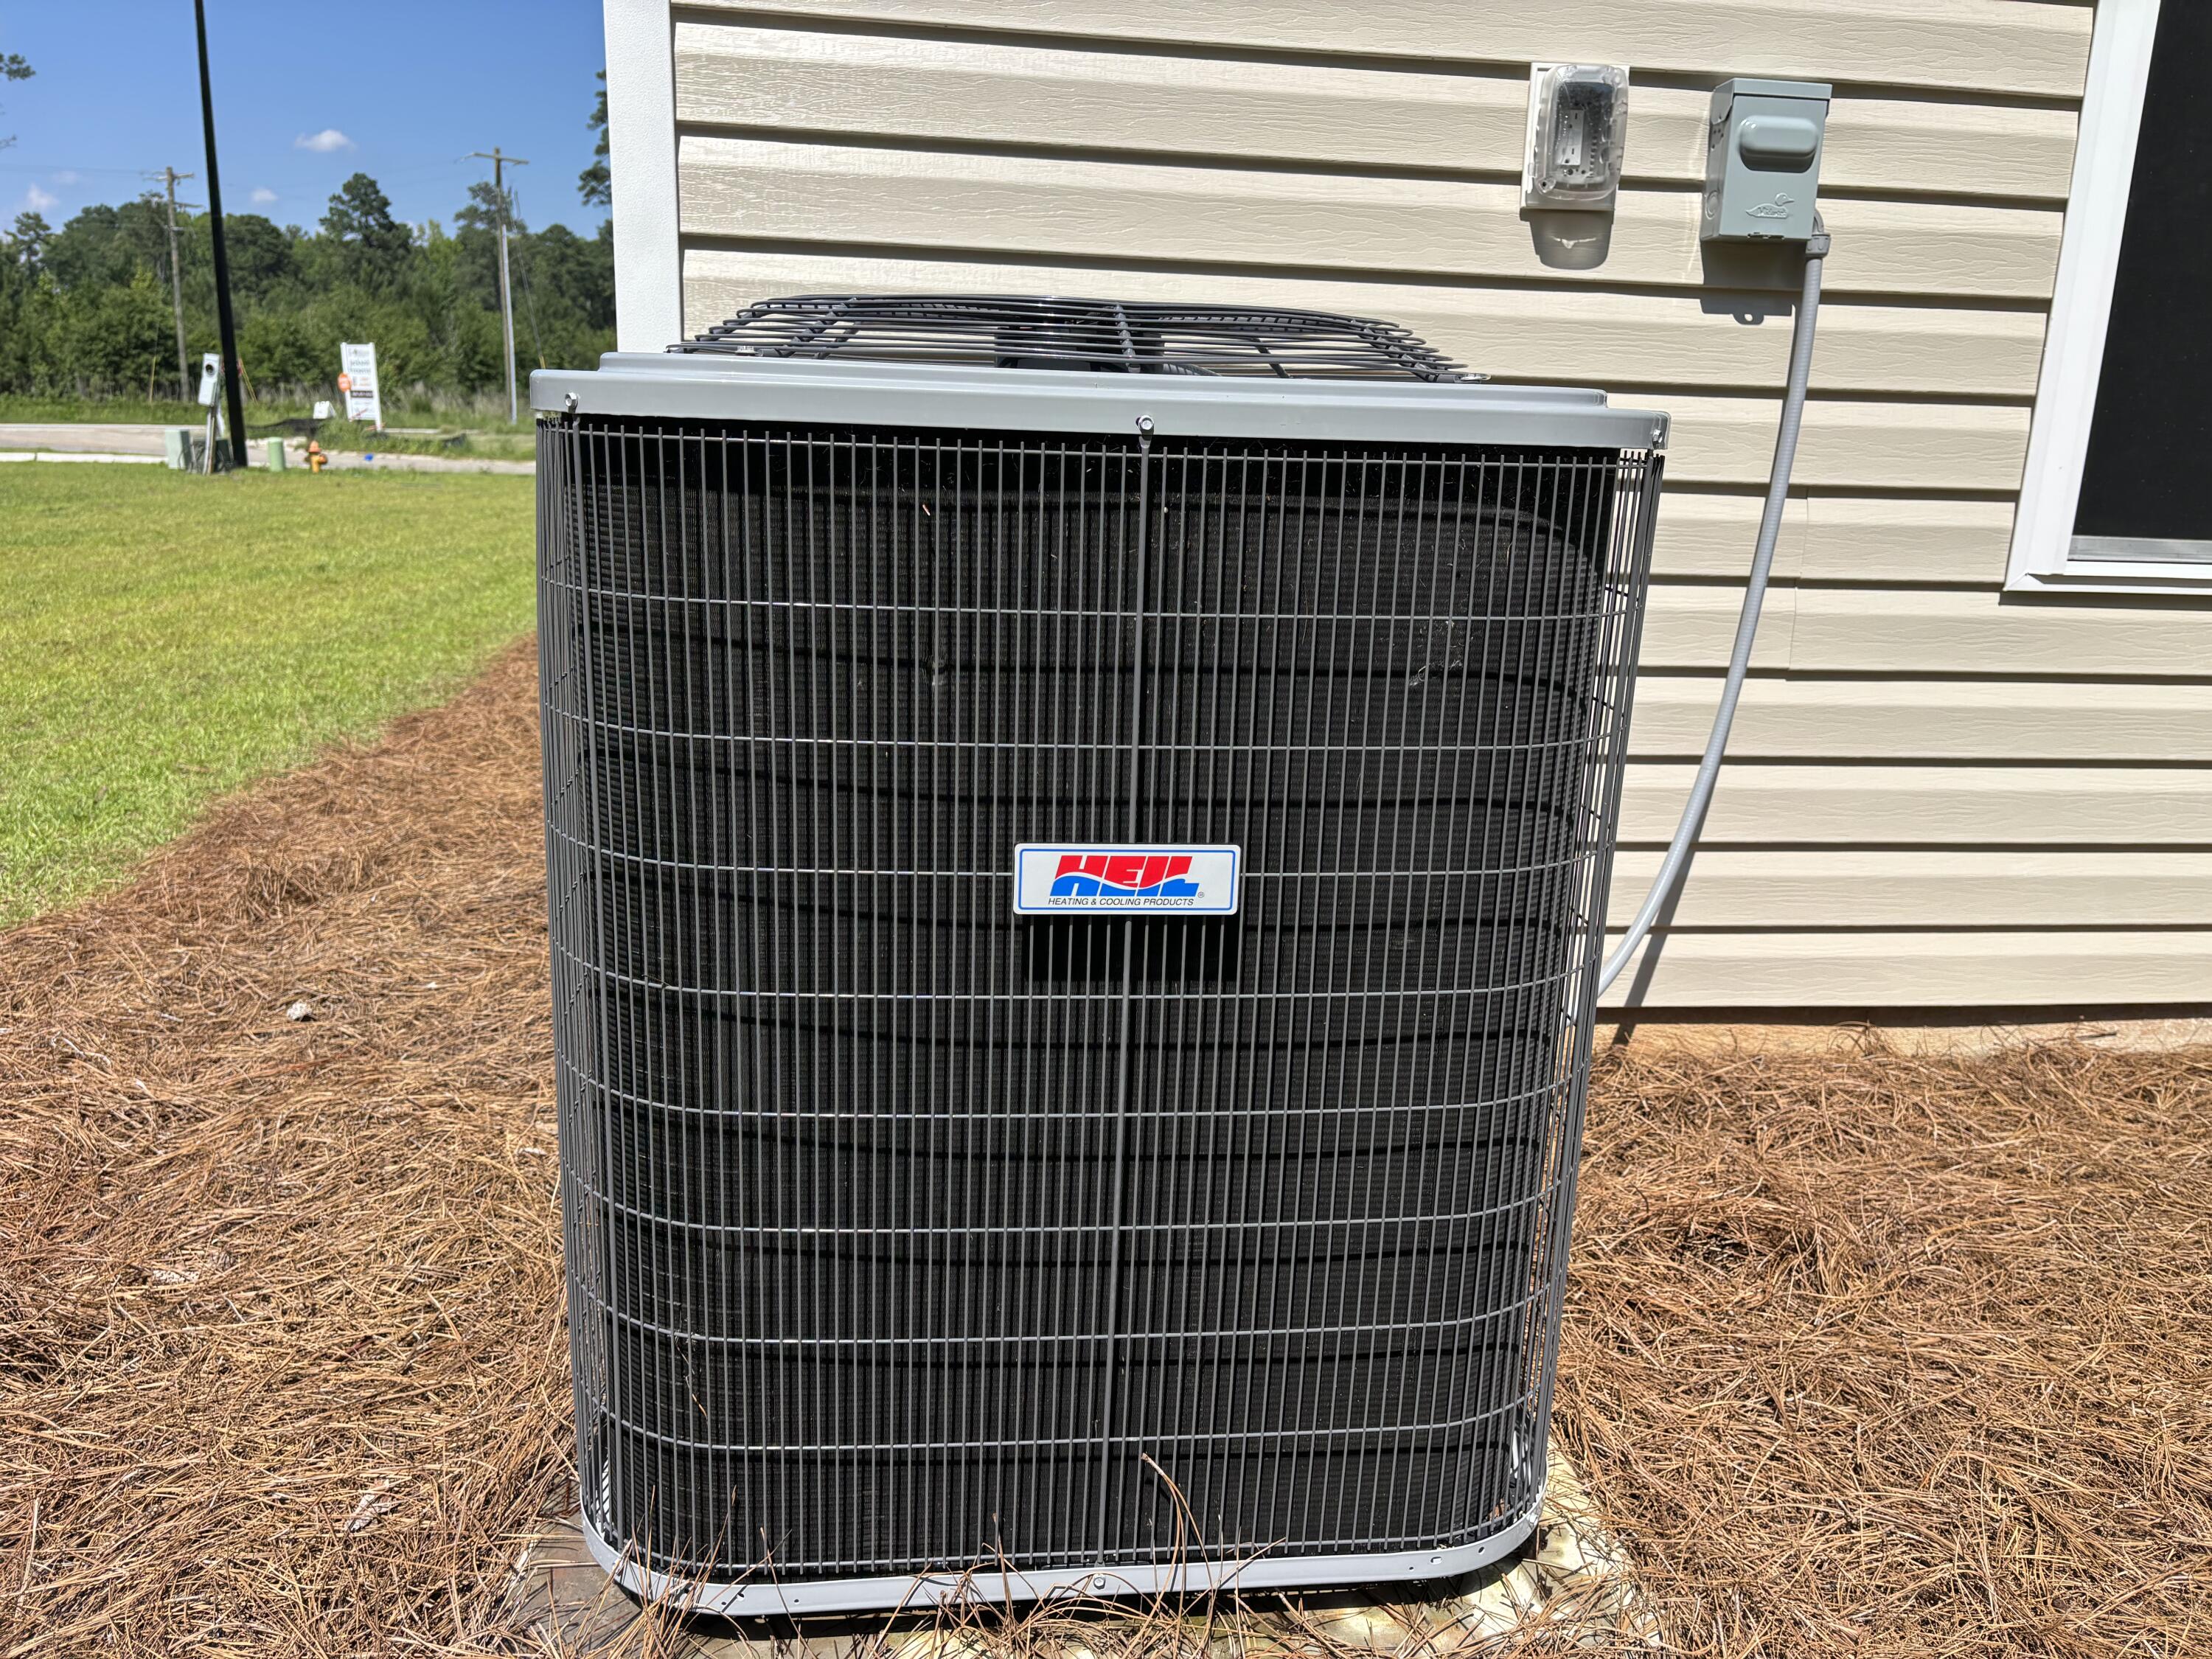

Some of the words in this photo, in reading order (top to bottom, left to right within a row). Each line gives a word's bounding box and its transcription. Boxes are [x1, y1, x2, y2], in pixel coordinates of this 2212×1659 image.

[1050, 855, 1200, 897] HEIL
[1048, 897, 1088, 905] HEATING
[1099, 898, 1141, 906] COOLING
[1143, 898, 1194, 906] PRODUCTS
